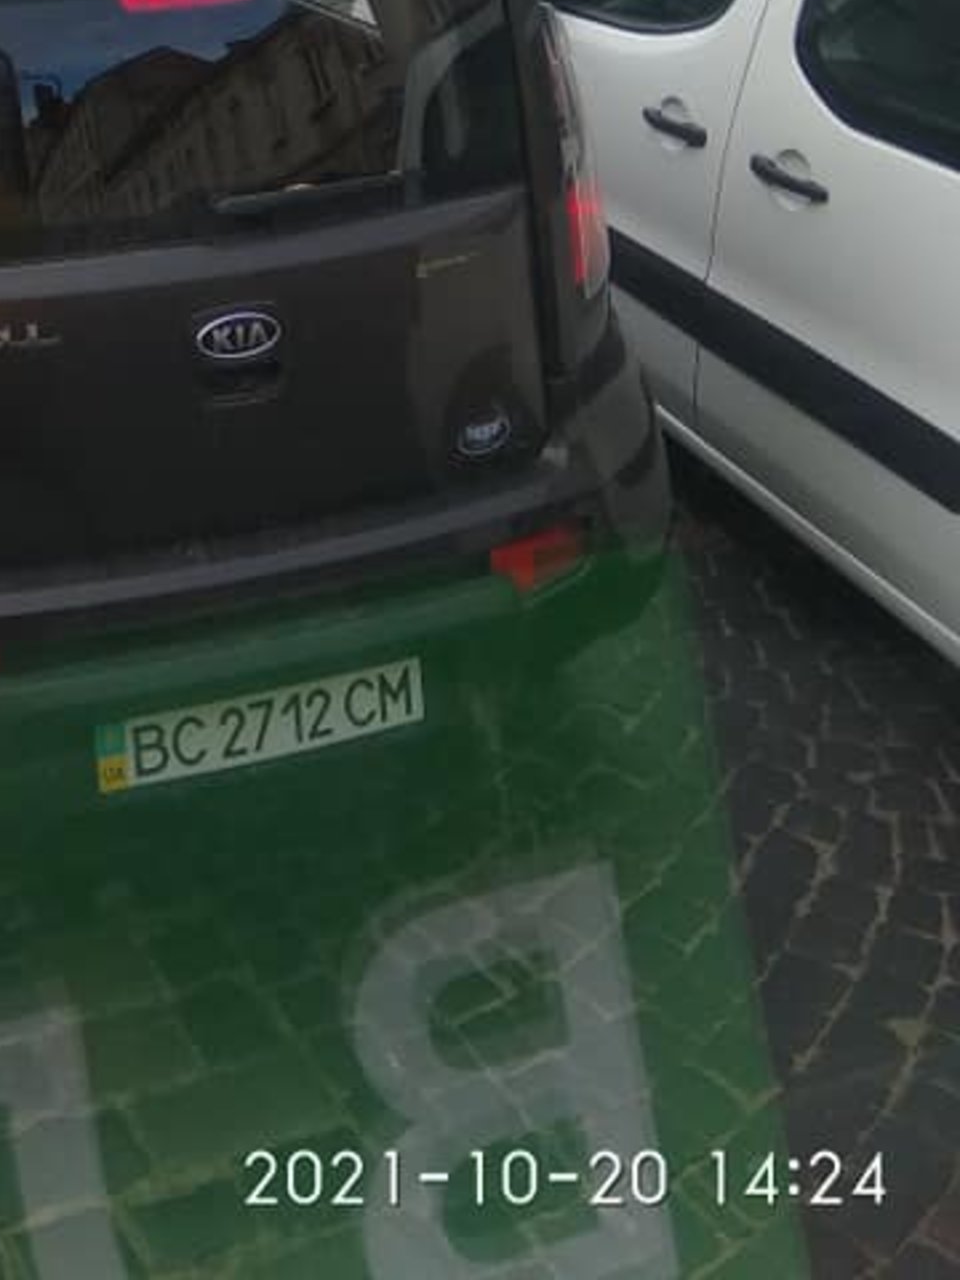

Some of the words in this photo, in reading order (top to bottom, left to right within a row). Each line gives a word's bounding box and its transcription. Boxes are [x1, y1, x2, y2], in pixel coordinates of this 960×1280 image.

[210, 320, 272, 354] KIA
[130, 716, 207, 778] BC
[219, 688, 334, 758] 2712
[343, 666, 413, 727] CM
